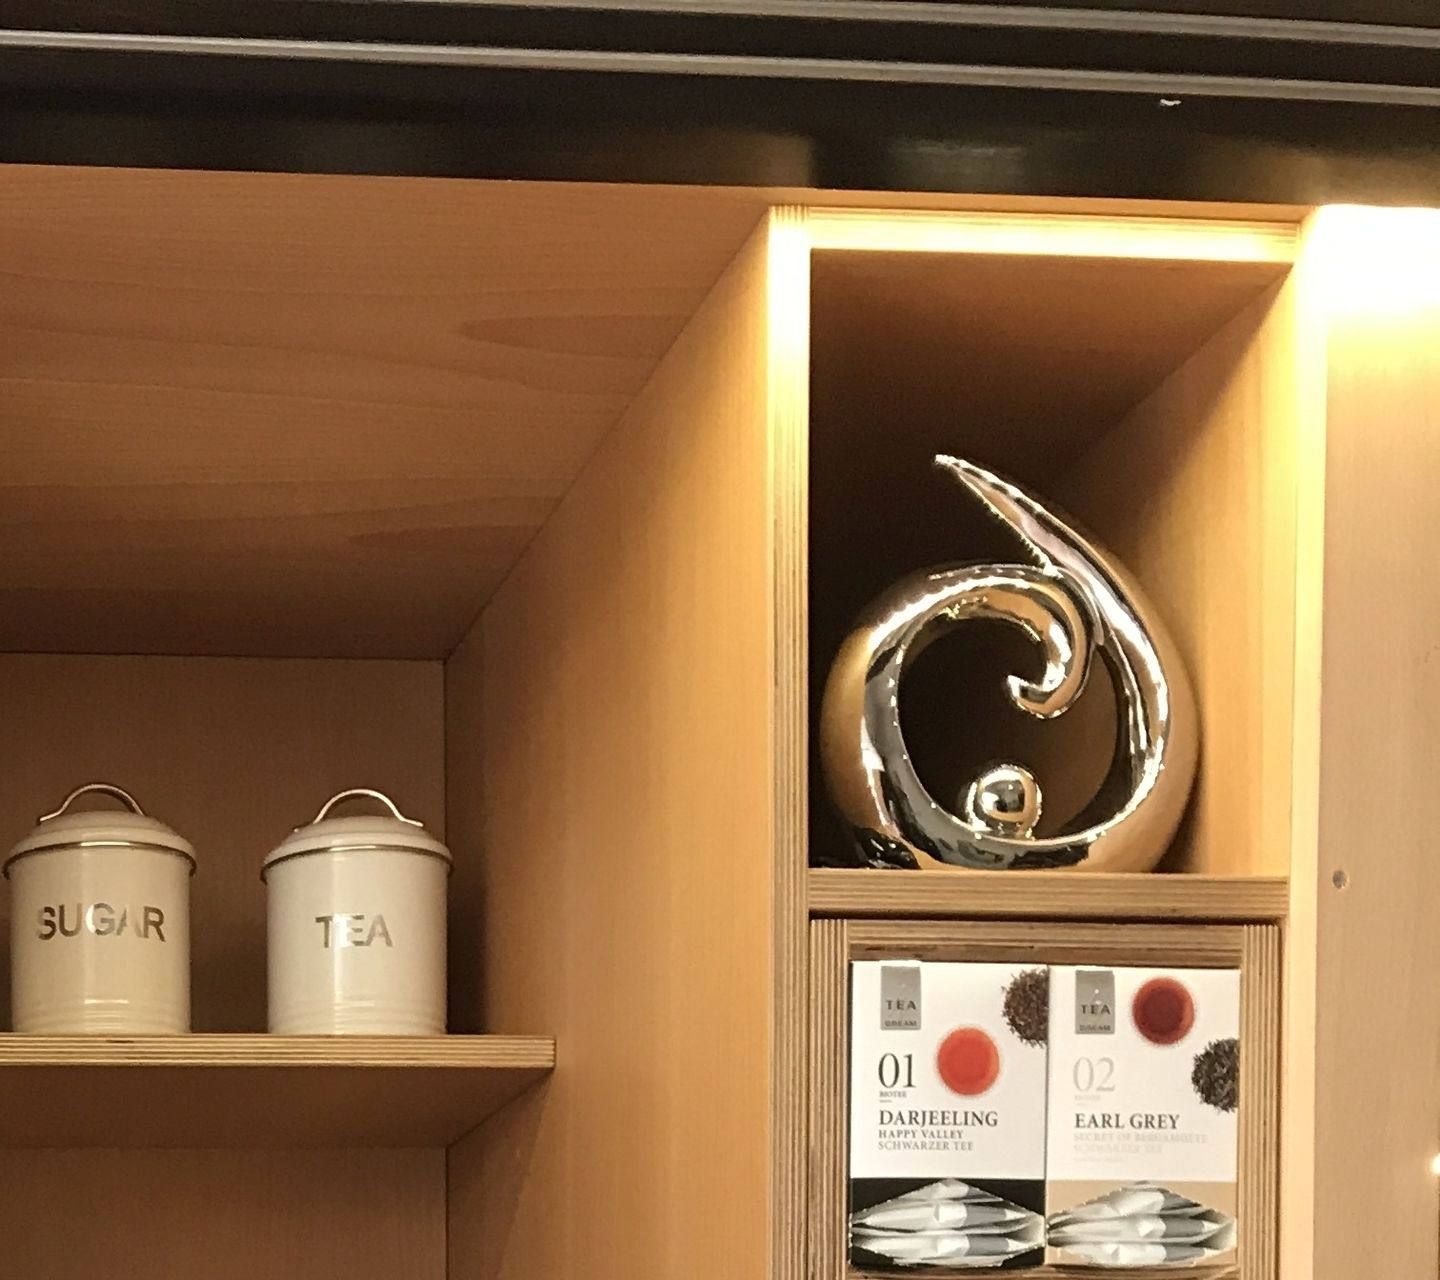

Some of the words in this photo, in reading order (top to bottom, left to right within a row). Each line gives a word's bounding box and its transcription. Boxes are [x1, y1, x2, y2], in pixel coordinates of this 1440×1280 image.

[35, 902, 167, 943] SUGAR
[315, 913, 394, 950] TEA
[886, 1000, 916, 1010] TEA
[1081, 1004, 1110, 1015] TEA
[878, 1052, 917, 1089] 01
[1073, 1057, 1116, 1092] 02
[879, 1110, 998, 1127] DARJEELING
[1074, 1113, 1125, 1129] EARL
[1130, 1113, 1180, 1129] GREY
[878, 1129, 917, 1139] HAPPY
[921, 1129, 964, 1139] VALLEY
[878, 1141, 950, 1151] SCHWARZER
[953, 1142, 973, 1151] TEE
